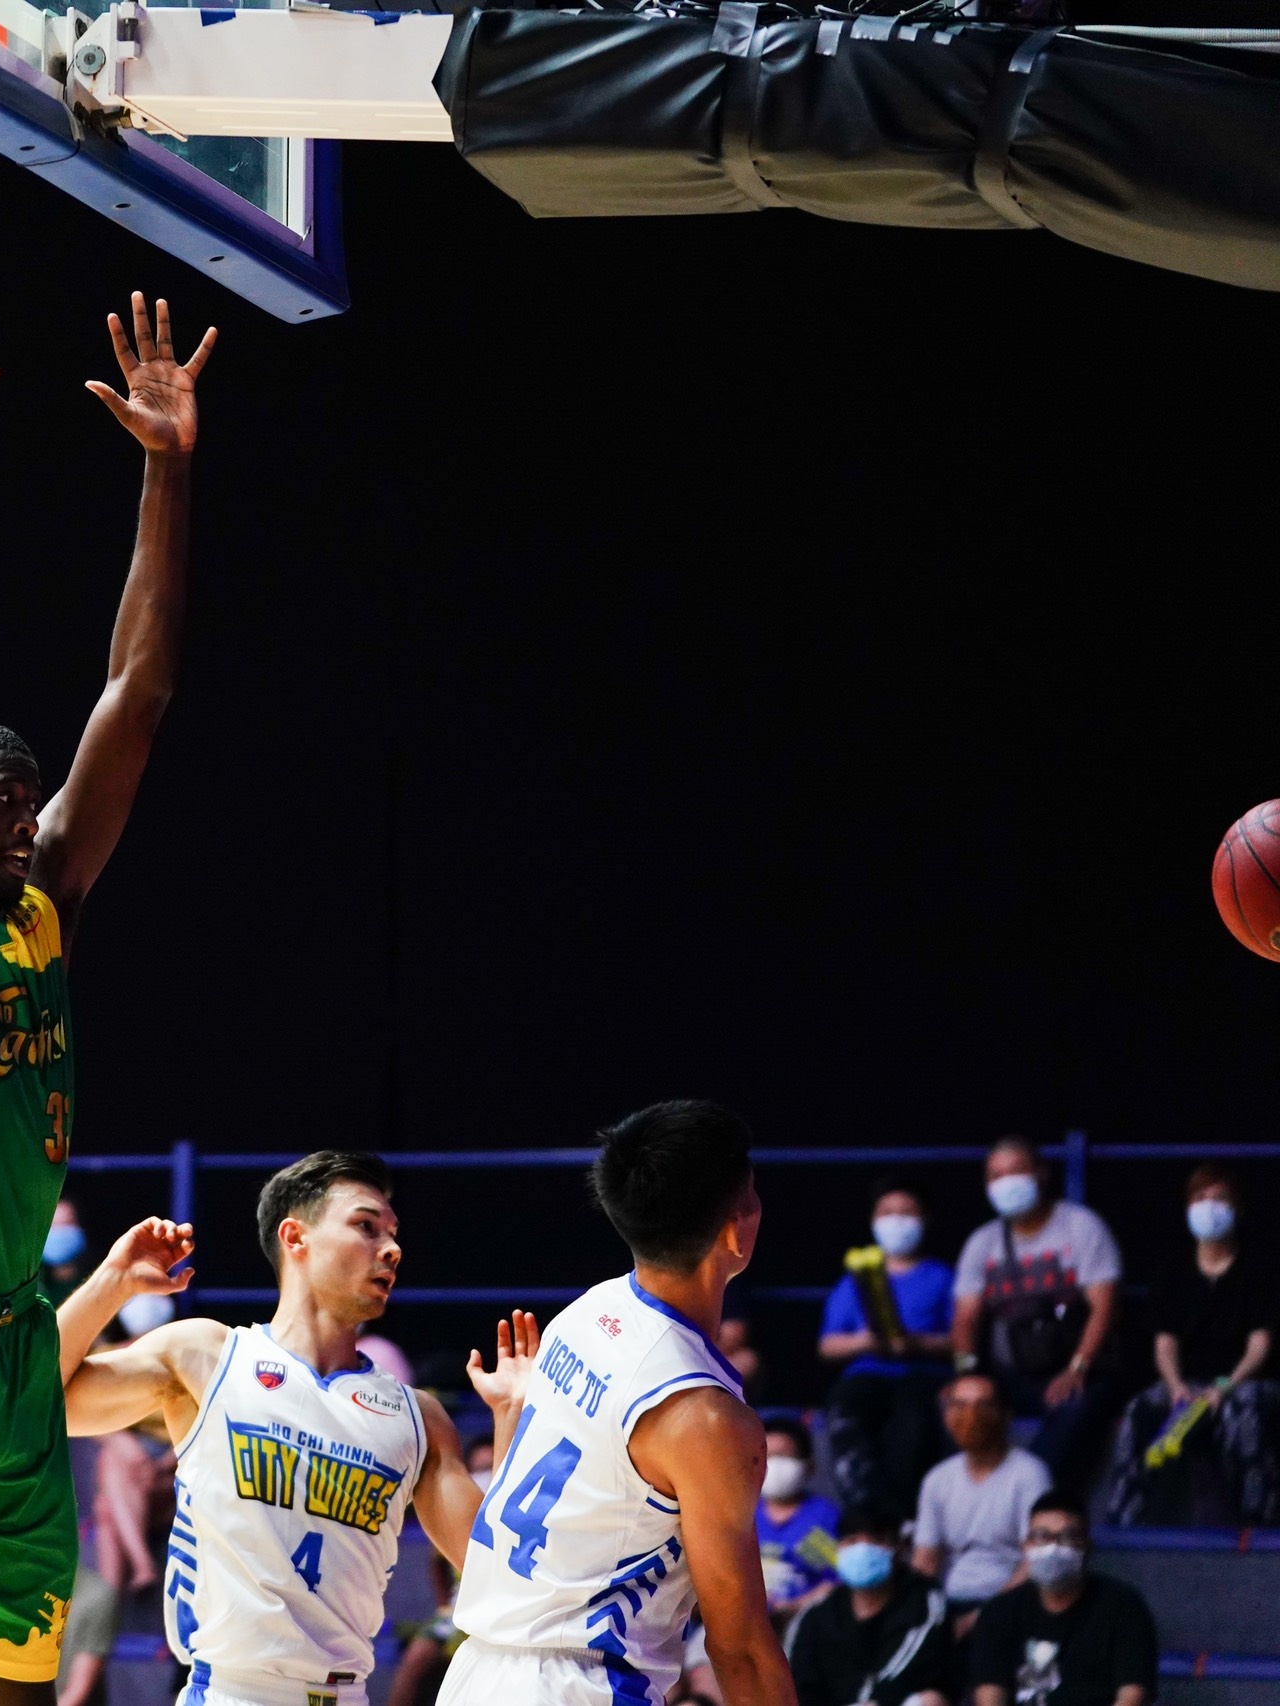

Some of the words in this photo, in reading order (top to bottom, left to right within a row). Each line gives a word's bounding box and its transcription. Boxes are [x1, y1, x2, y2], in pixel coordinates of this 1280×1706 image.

[258, 1361, 284, 1374] VBA
[231, 1430, 300, 1509] CITY
[298, 1431, 323, 1450] CHI
[330, 1441, 371, 1463] MINH
[471, 1404, 582, 1581] 14
[291, 1531, 324, 1592] 4
